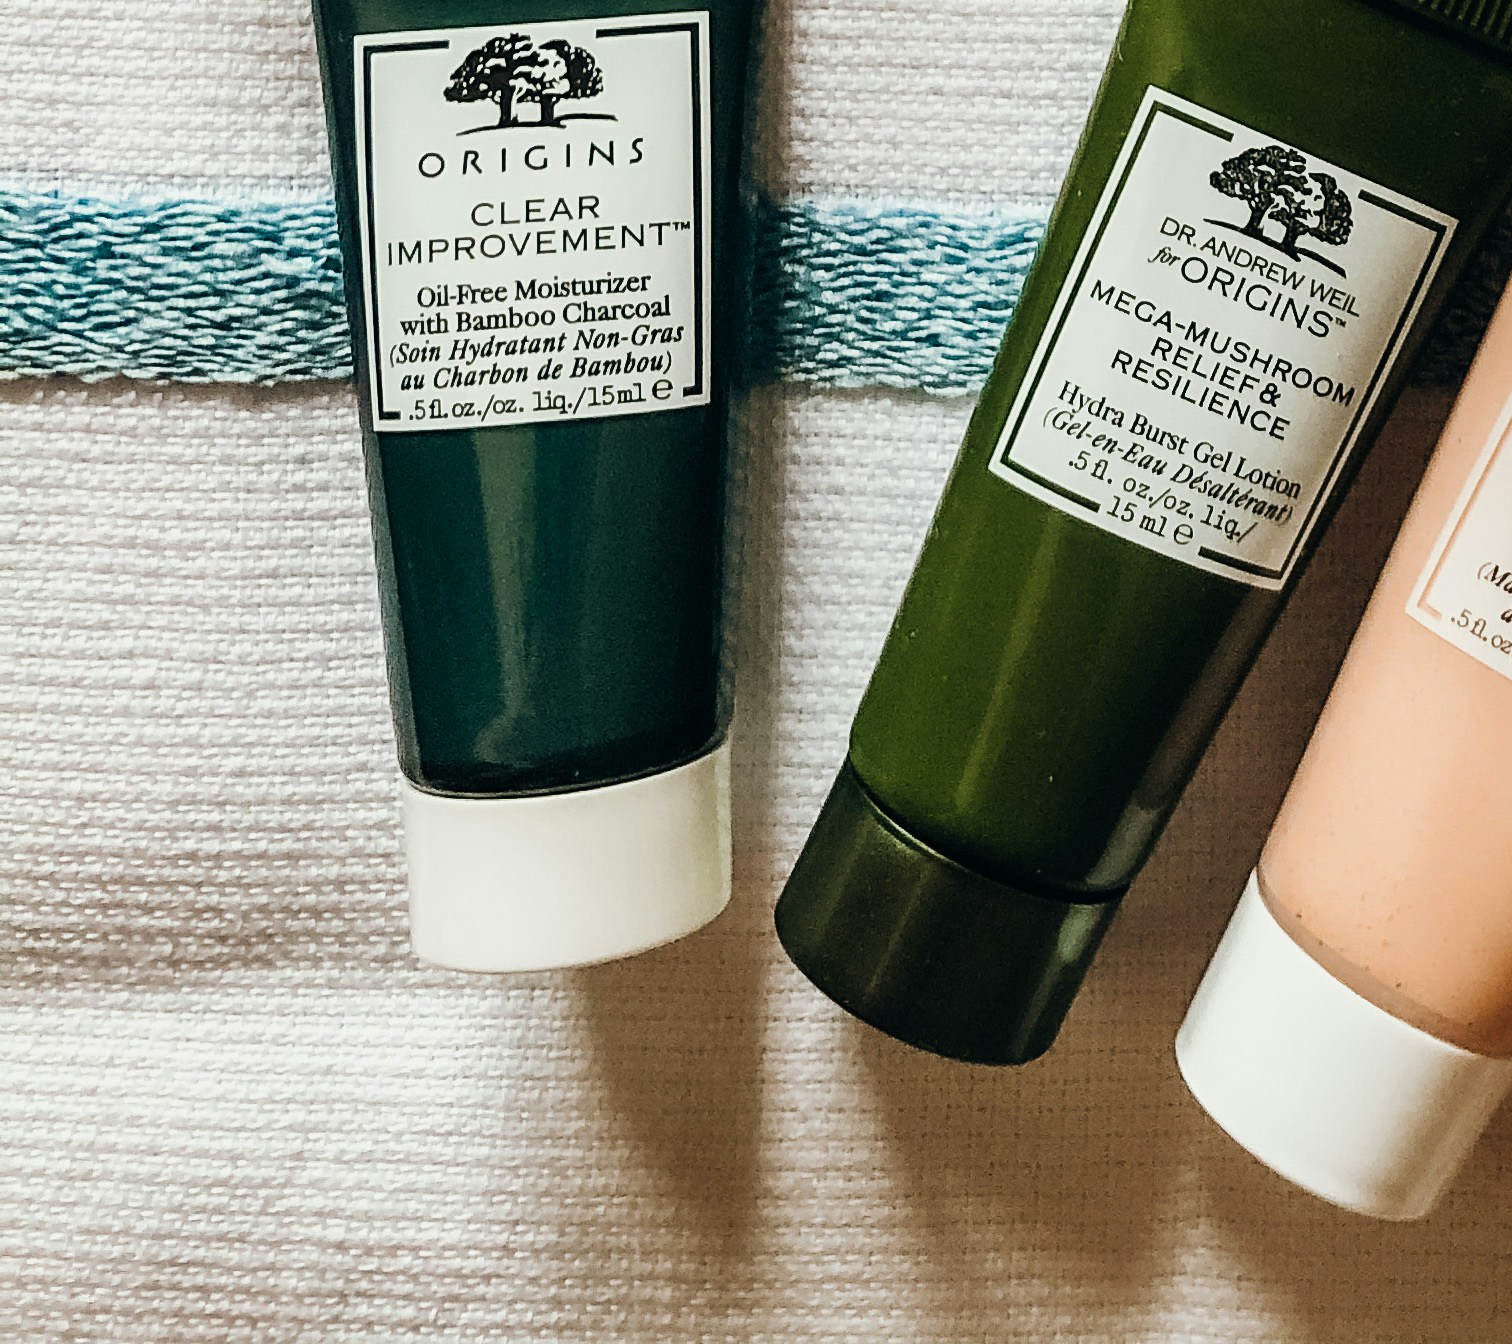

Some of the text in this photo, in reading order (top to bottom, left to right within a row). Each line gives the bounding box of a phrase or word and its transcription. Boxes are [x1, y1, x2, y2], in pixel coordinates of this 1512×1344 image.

[418, 137, 645, 178] ORIGINS
[470, 196, 600, 226] CLEAR
[1147, 246, 1180, 267] for
[1160, 217, 1360, 317] DR. ANDREW WEIL
[416, 272, 651, 309] Oil-Free Moisturizer
[400, 296, 671, 335] with Bamboo Charcoal
[390, 322, 684, 368] (Soin Hydratant Non-Gras
[1090, 280, 1356, 407] MEGA-MUSHROOM
[400, 351, 672, 390] au Charbon de Bambou)
[1151, 337, 1260, 396] RELIEF
[1111, 350, 1291, 441] RESILIENCE
[1058, 380, 1301, 499] Hydra Burst Gel Lotion
[1042, 406, 1293, 527] (Gel-en-Eau Désaltérant)
[1106, 498, 1135, 523] 15
[1138, 514, 1167, 537] ml
